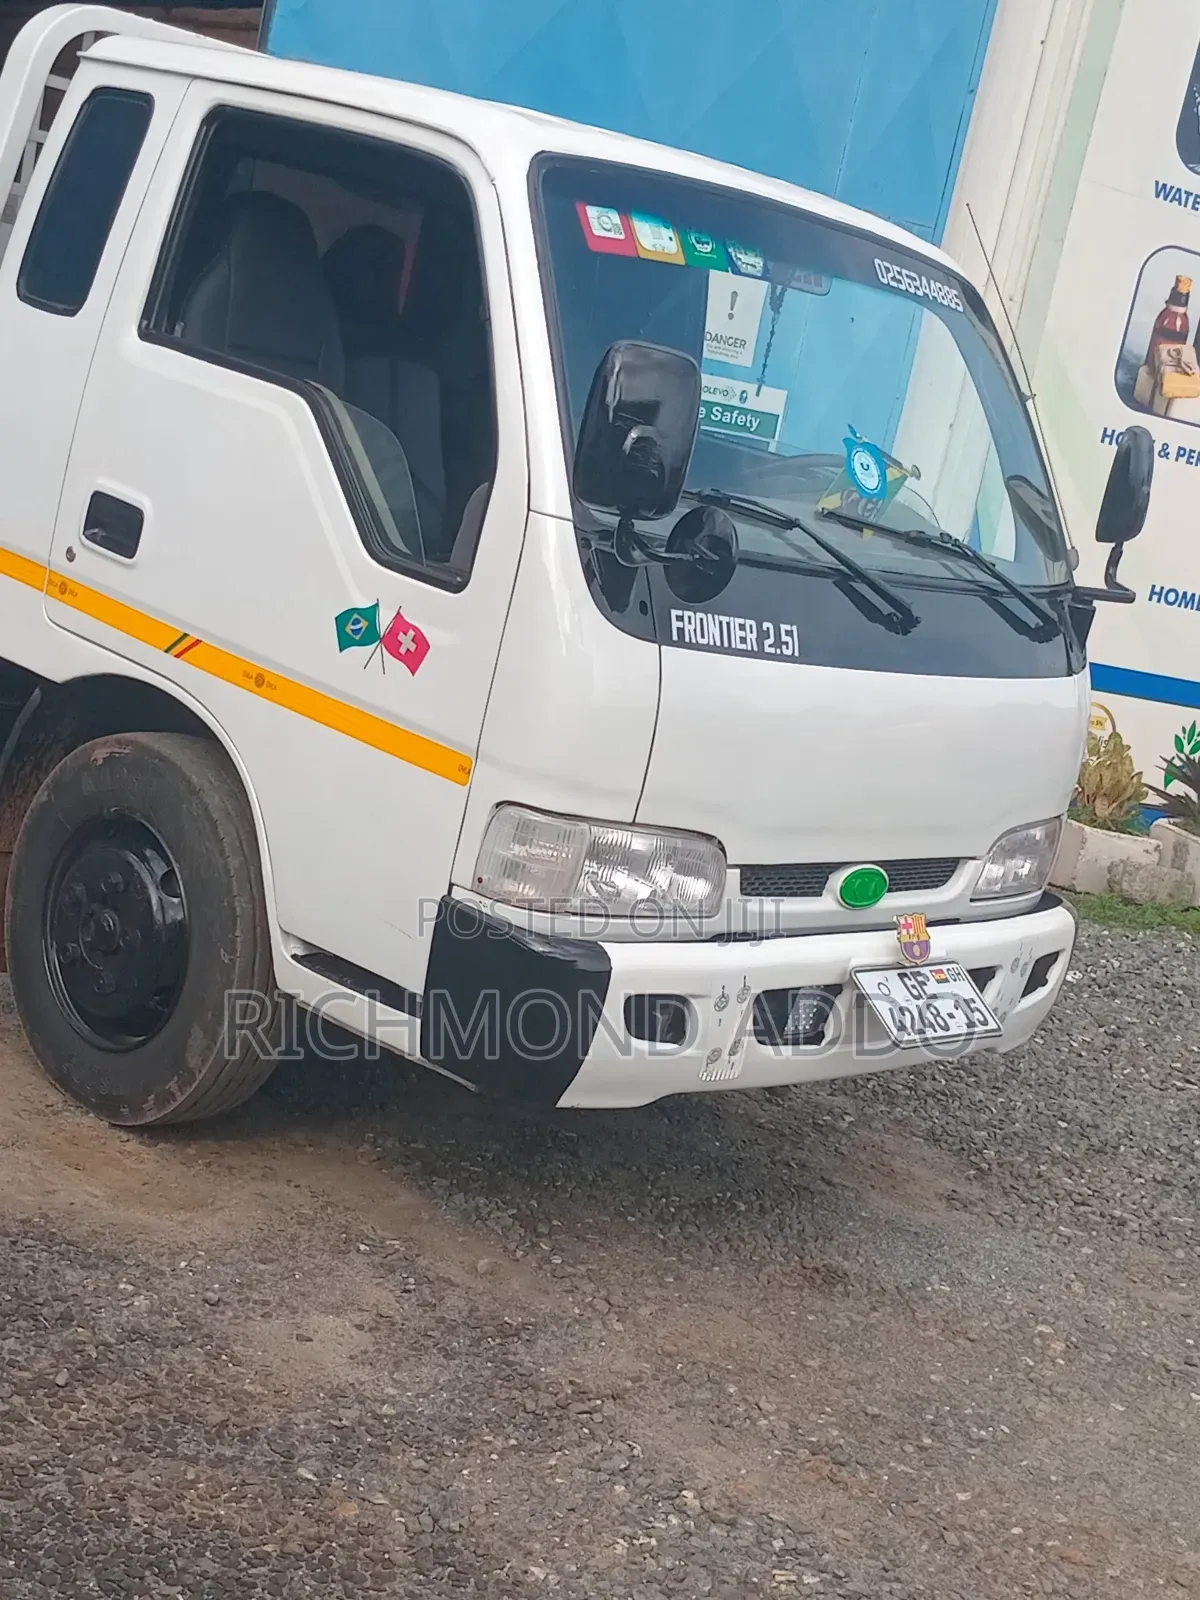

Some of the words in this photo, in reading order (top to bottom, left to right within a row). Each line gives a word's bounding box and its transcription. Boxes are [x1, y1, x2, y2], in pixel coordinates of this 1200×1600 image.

[874, 258, 964, 312] 0256344885
[705, 331, 747, 349] DANGER
[710, 406, 760, 431] Safety
[1157, 442, 1170, 460] &
[670, 608, 758, 652] FRONTIER
[946, 967, 965, 983] GH
